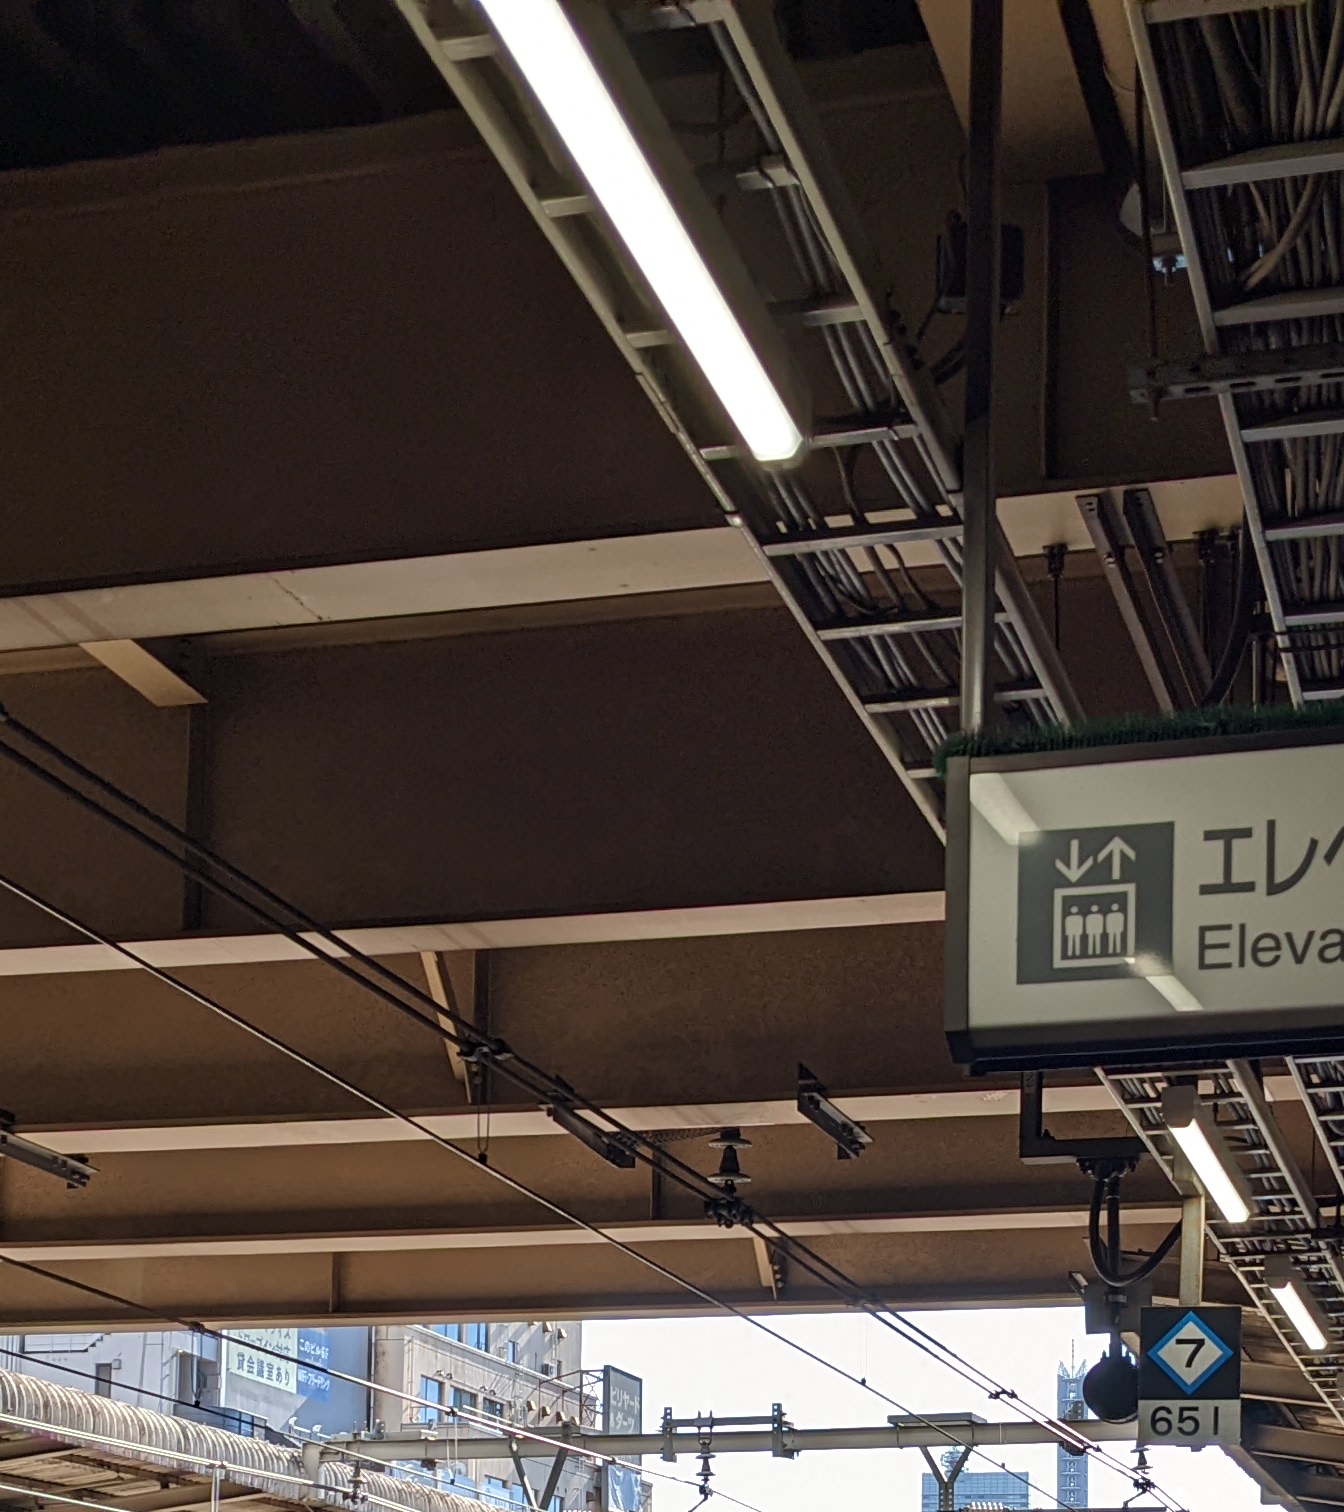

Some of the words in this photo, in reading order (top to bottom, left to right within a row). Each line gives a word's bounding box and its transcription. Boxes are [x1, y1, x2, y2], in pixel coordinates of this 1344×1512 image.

[1175, 1338, 1205, 1368] 7
[236, 1351, 290, 1386] 貸会議室あり
[610, 1386, 641, 1414] ビリヤード
